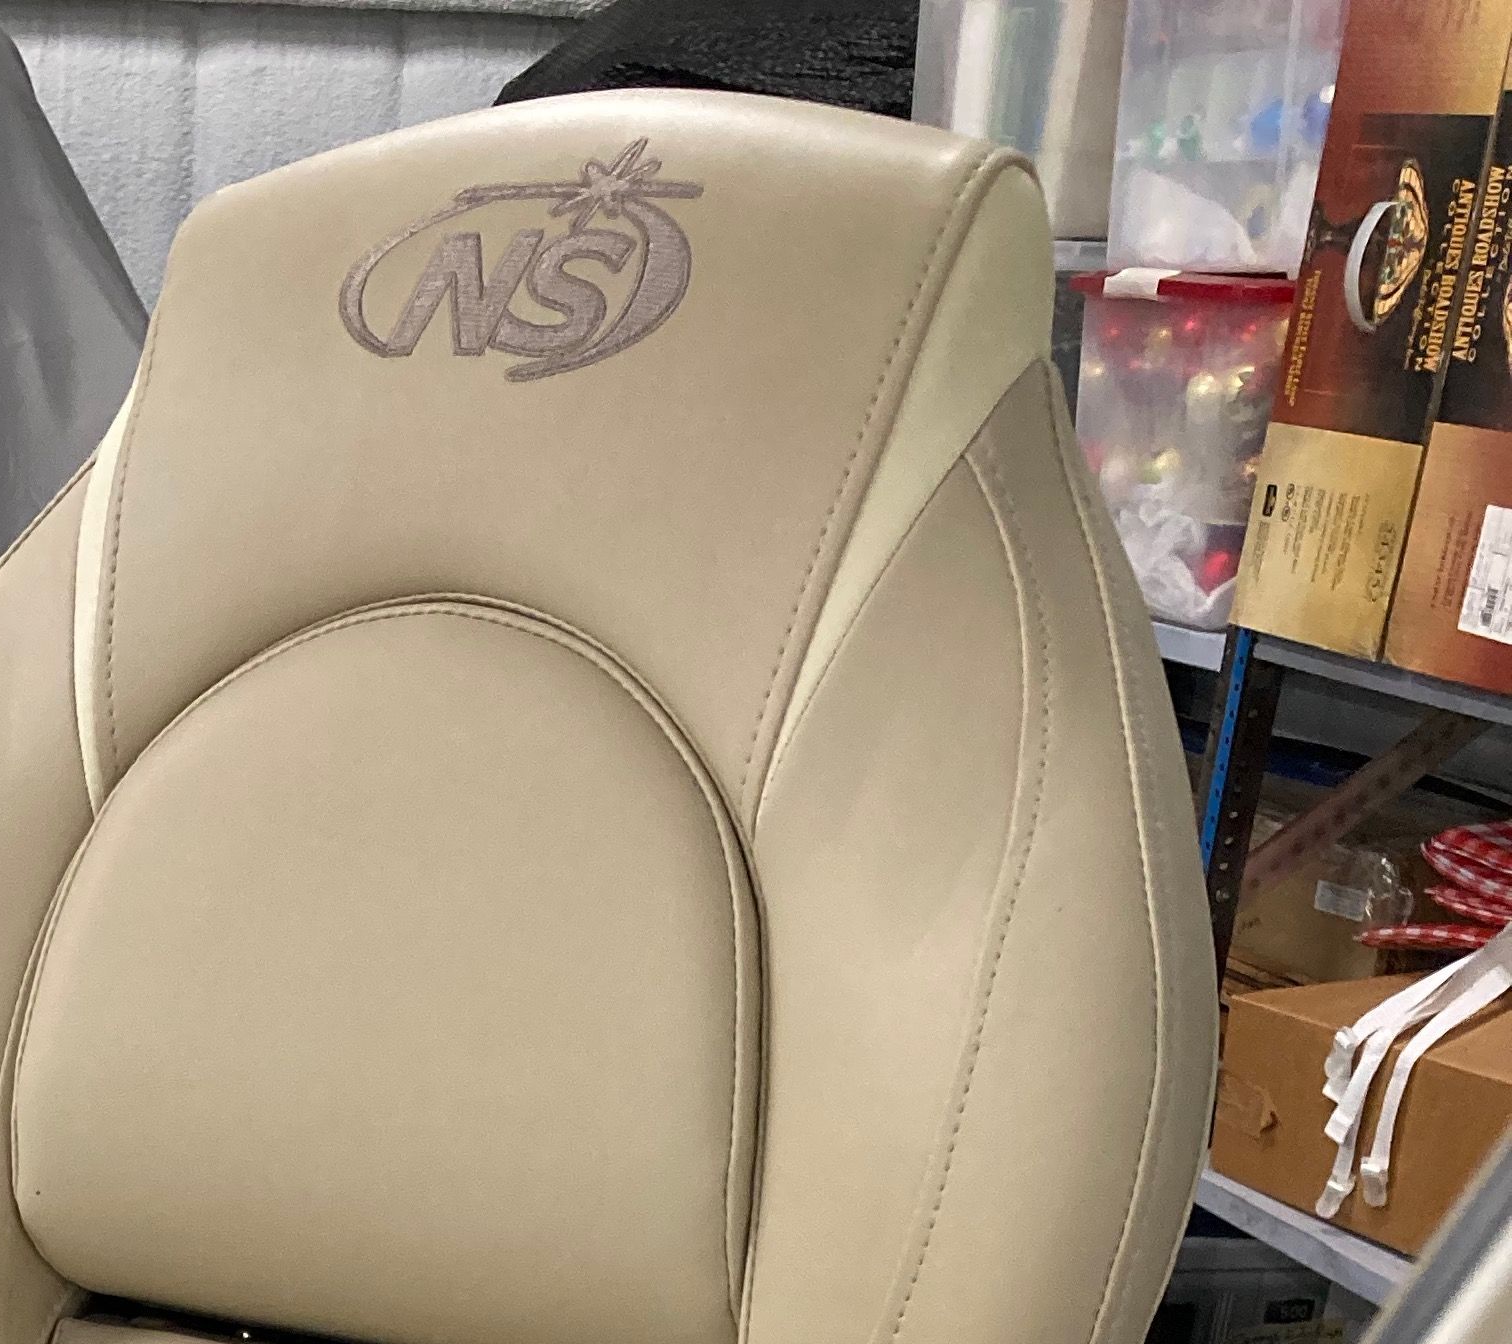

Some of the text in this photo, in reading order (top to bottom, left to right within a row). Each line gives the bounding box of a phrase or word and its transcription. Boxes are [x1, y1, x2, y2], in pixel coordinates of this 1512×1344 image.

[385, 229, 637, 358] NS
[1414, 178, 1462, 372] COLLECTION
[1423, 178, 1476, 374] ANTIQUES ROADSHOW
[1452, 270, 1485, 361] ANTIQUES
[1472, 165, 1505, 267] ROADSHOW
[1467, 164, 1512, 364] COLLECTION
